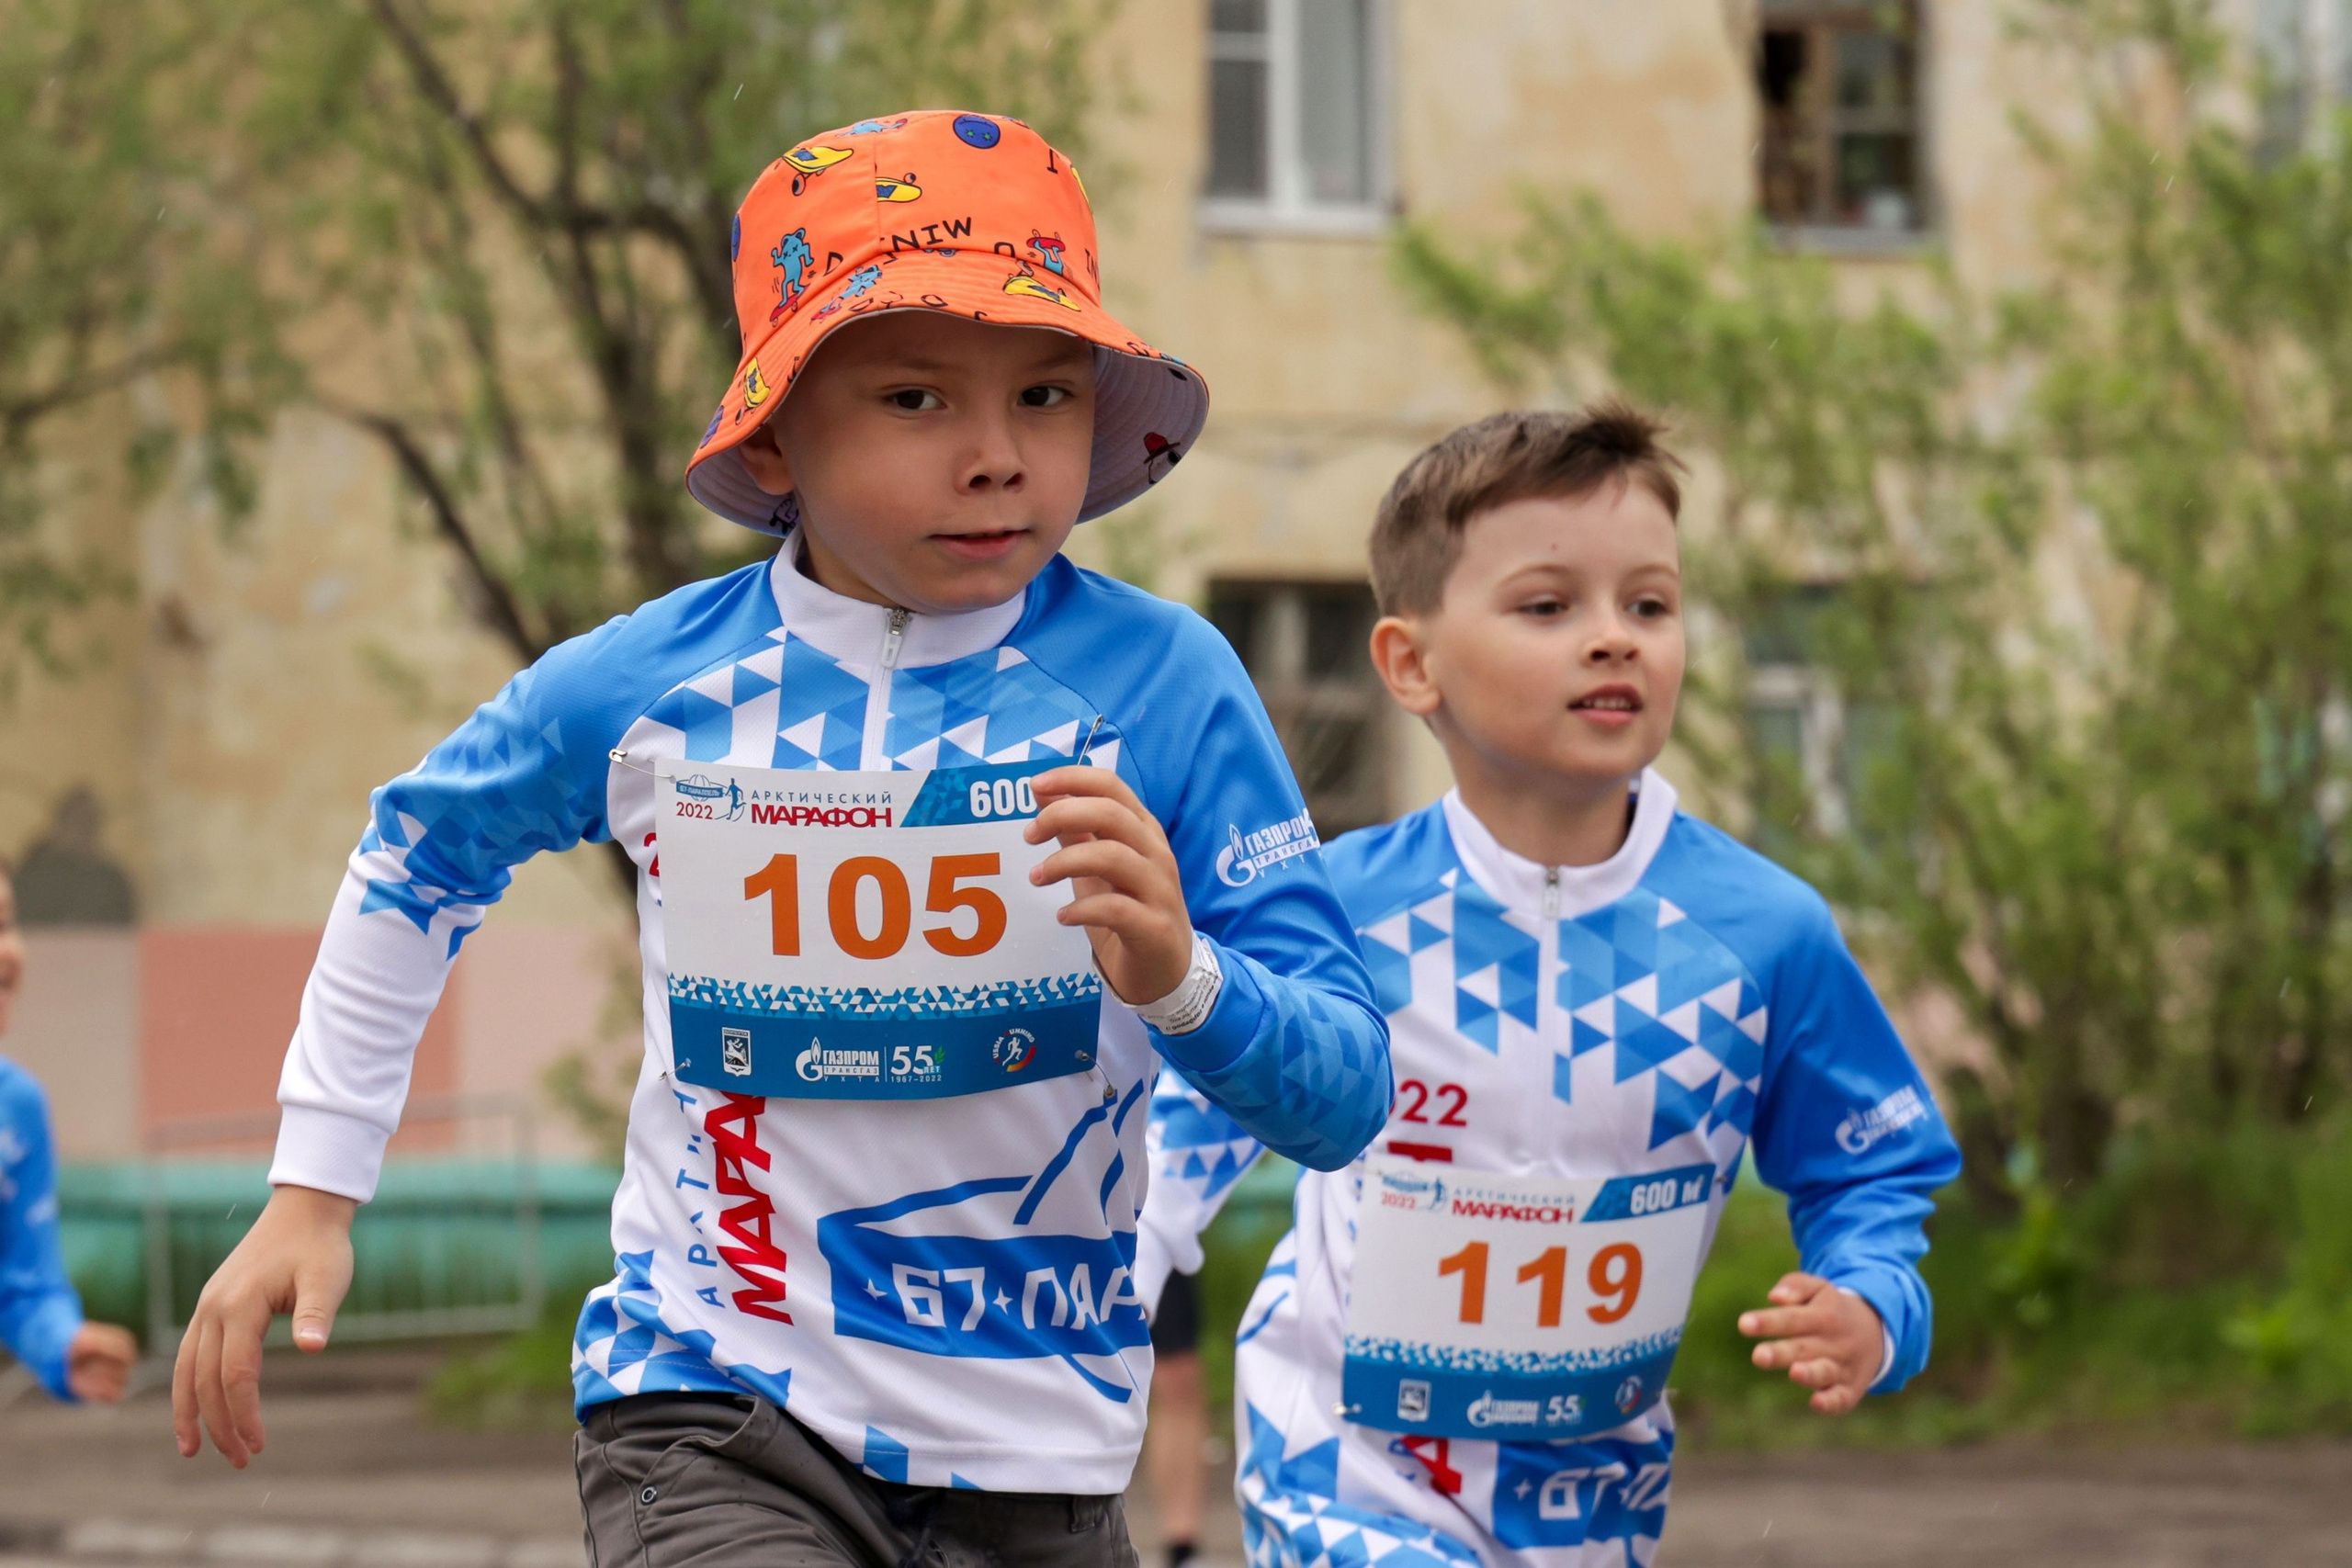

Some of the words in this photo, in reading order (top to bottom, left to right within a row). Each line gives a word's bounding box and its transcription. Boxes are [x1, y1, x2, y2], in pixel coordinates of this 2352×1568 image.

[676, 801, 713, 819] 2022
[752, 790, 892, 804] АРКТИЧЕСКИЙ
[969, 776, 1038, 818] 600
[752, 804, 892, 828] МАРАФОН
[744, 852, 1008, 959] 105
[822, 1050, 879, 1066] ГАЗПРОМ
[890, 1045, 933, 1076] 55
[1389, 1078, 1468, 1128] 22
[704, 1090, 795, 1326] МАРА
[1453, 1199, 1574, 1224] МАРАФОН
[1630, 1178, 1678, 1214] 600
[891, 1262, 986, 1331] 67
[1438, 1240, 1644, 1328] 119
[1545, 1394, 1580, 1421] 55
